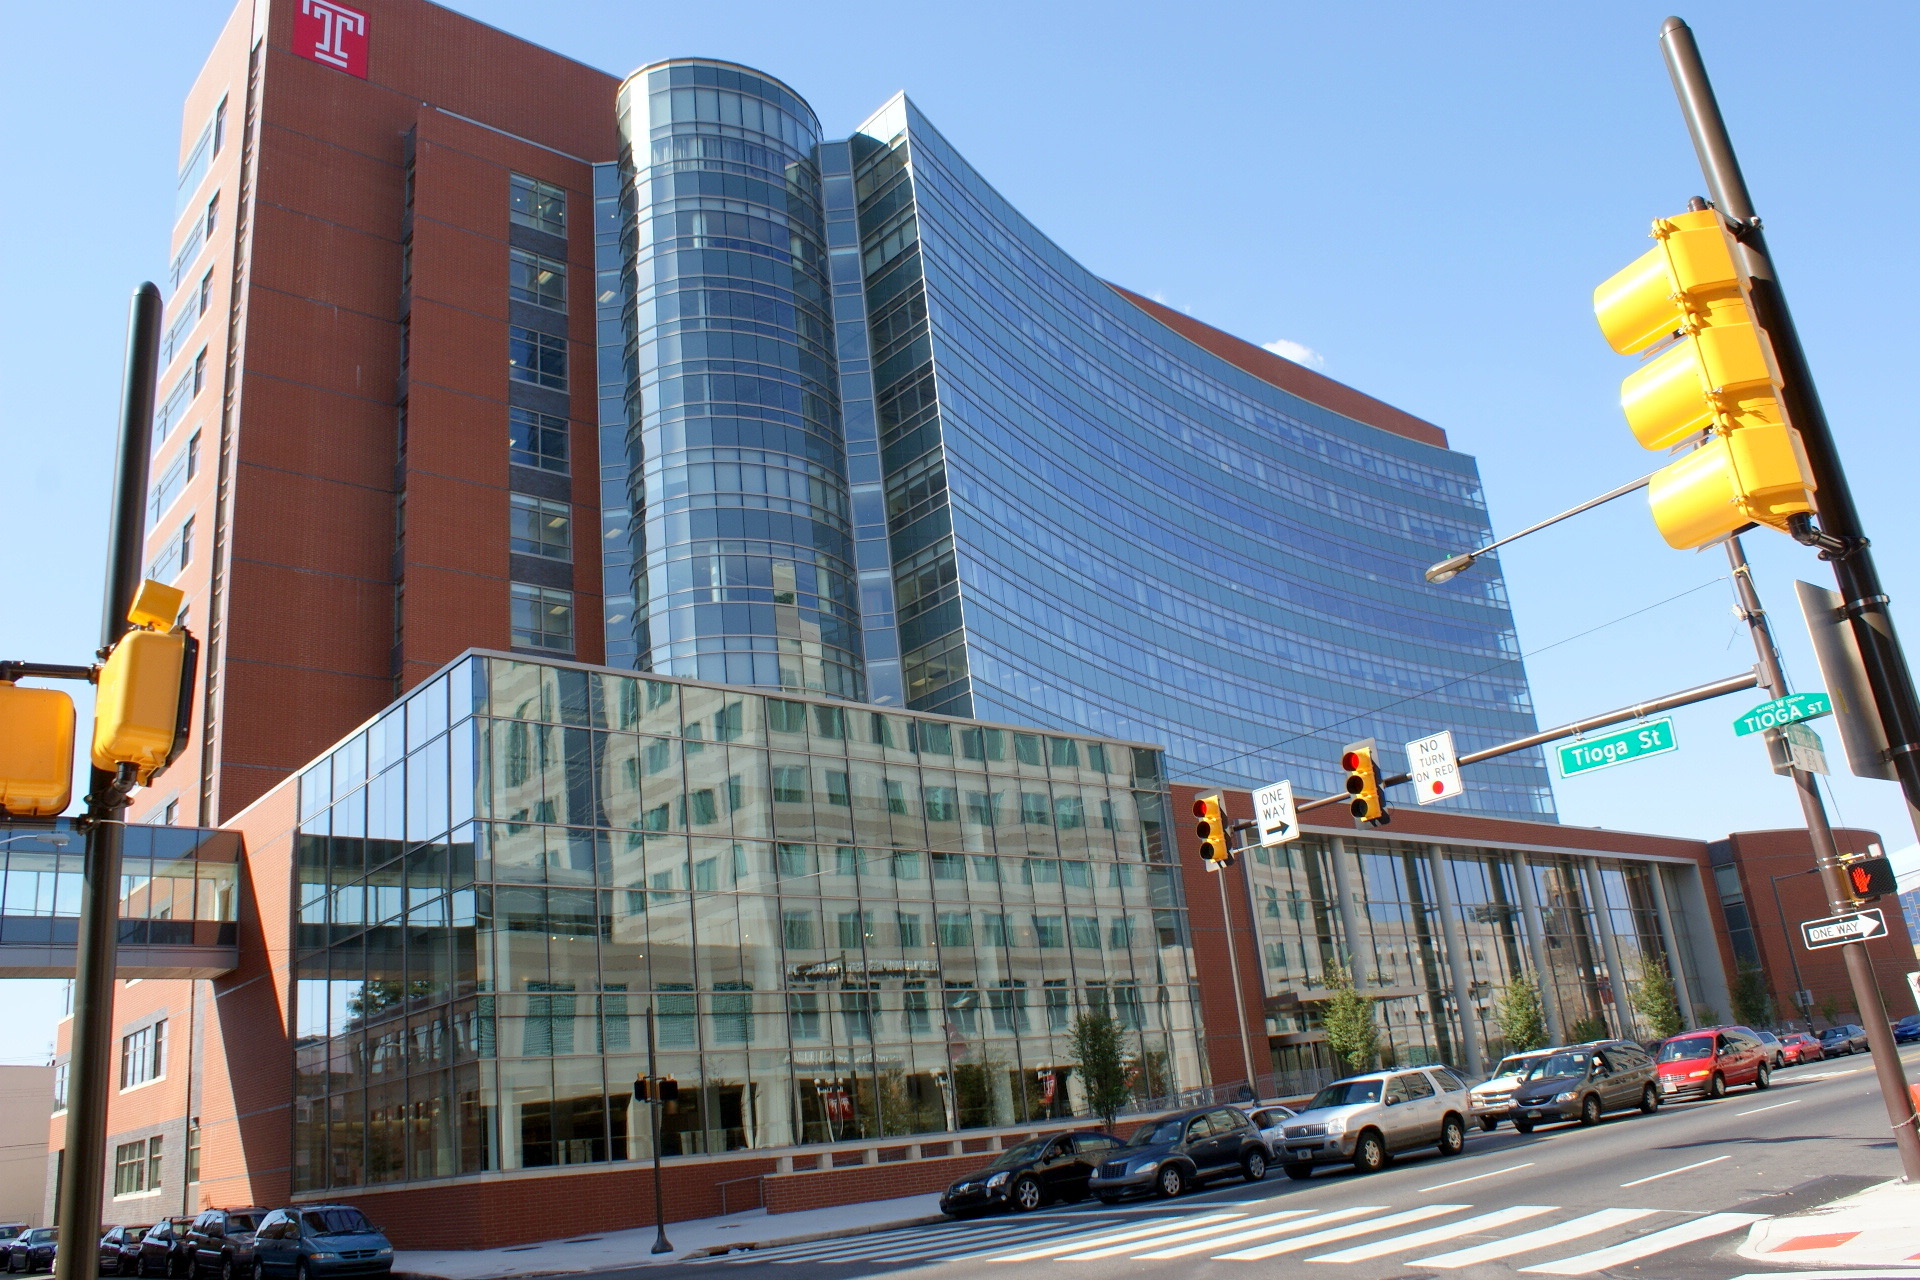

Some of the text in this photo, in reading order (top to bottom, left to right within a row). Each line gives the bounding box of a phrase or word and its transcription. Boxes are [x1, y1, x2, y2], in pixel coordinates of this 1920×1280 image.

[302, 0, 364, 69] T
[1775, 699, 1784, 708] W
[1744, 701, 1823, 732] TIOGA ST
[1420, 739, 1438, 754] NO
[1571, 730, 1662, 766] Tioga St
[1419, 752, 1446, 767] TURN
[1416, 763, 1454, 782] ON RED
[1261, 788, 1284, 805] ONE
[1262, 803, 1286, 820] WAY
[1812, 922, 1858, 939] ONE WAY
